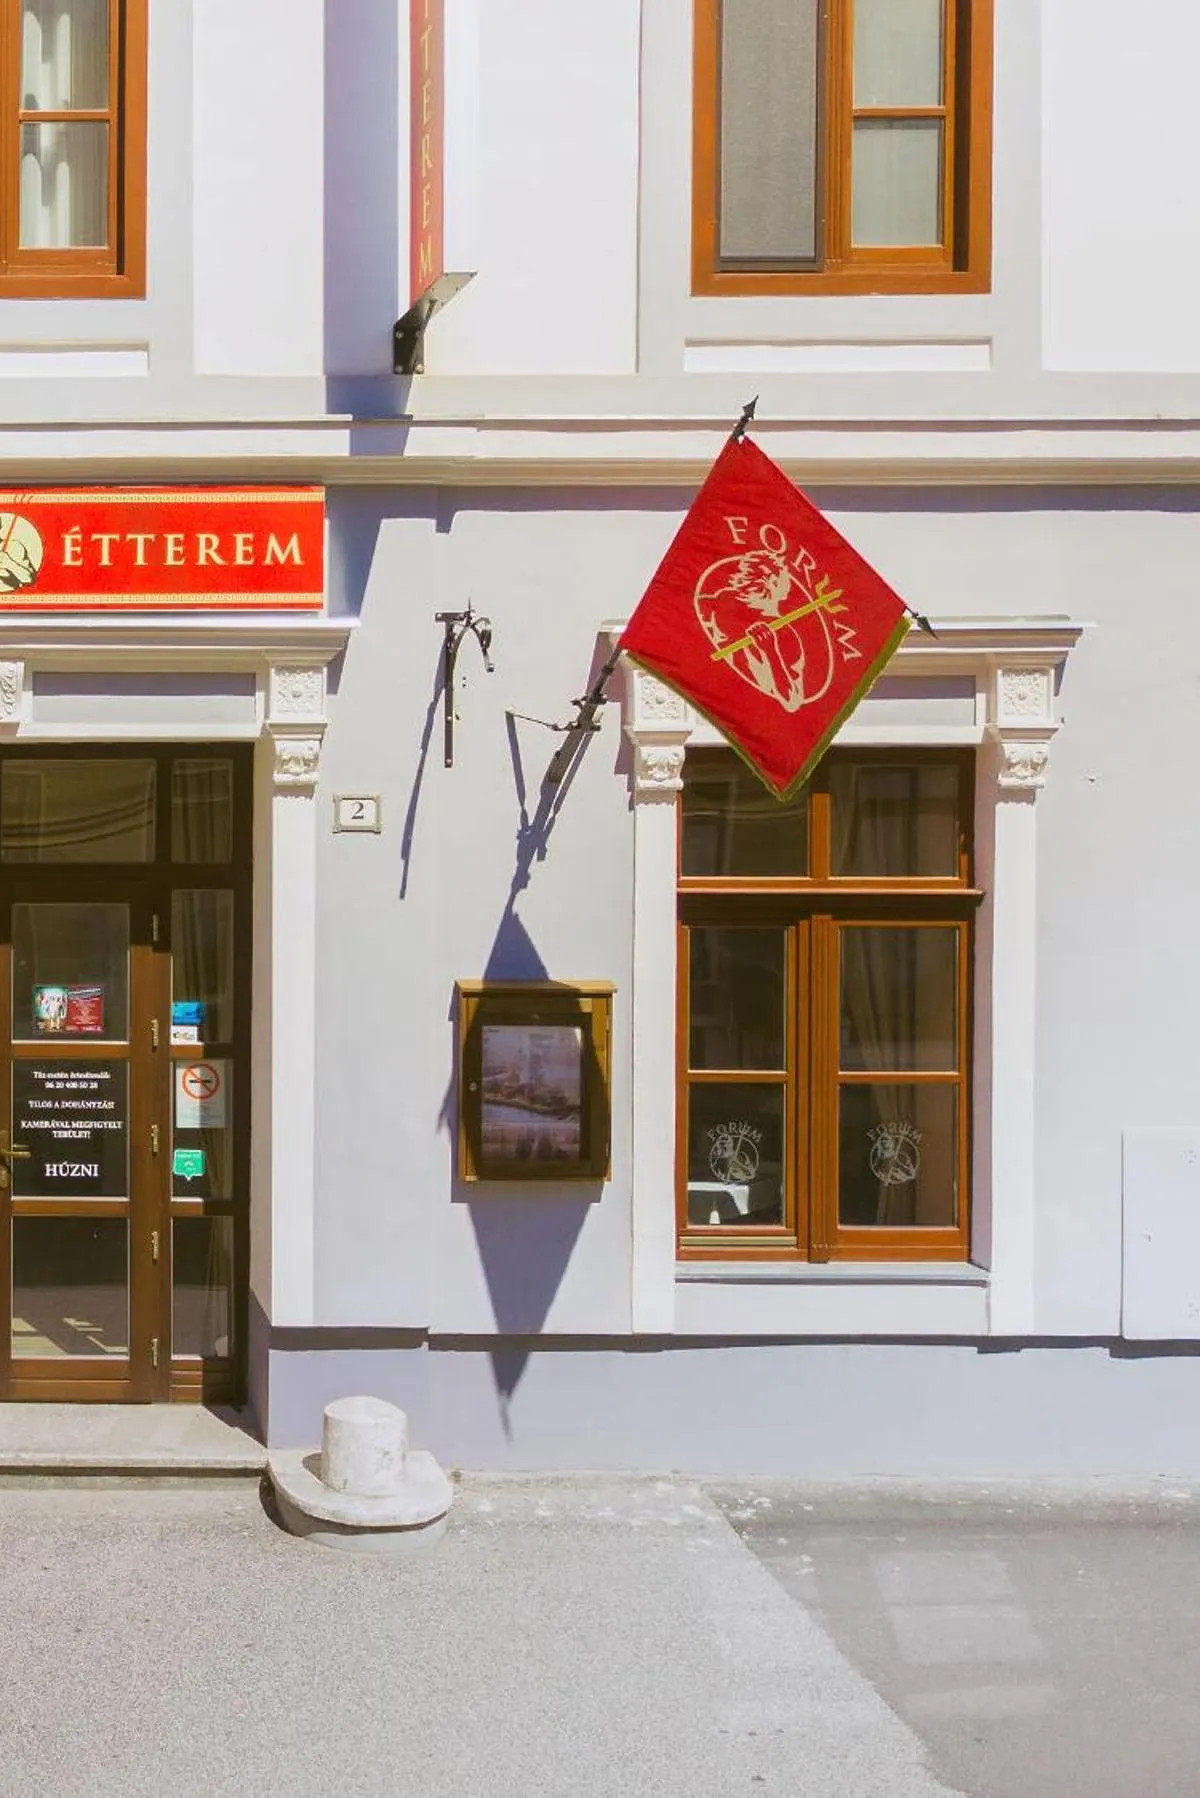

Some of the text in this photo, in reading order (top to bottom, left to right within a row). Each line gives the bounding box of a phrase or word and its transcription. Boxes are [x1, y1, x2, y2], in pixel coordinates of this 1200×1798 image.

[62, 525, 305, 567] ÉTTEREM
[351, 801, 364, 820] 2
[28, 1101, 52, 1109] TILOS
[54, 1101, 60, 1109] A
[21, 1120, 123, 1129] KAMERÁVAL MEGFIGYELT
[45, 1161, 99, 1177] HÚZNI
